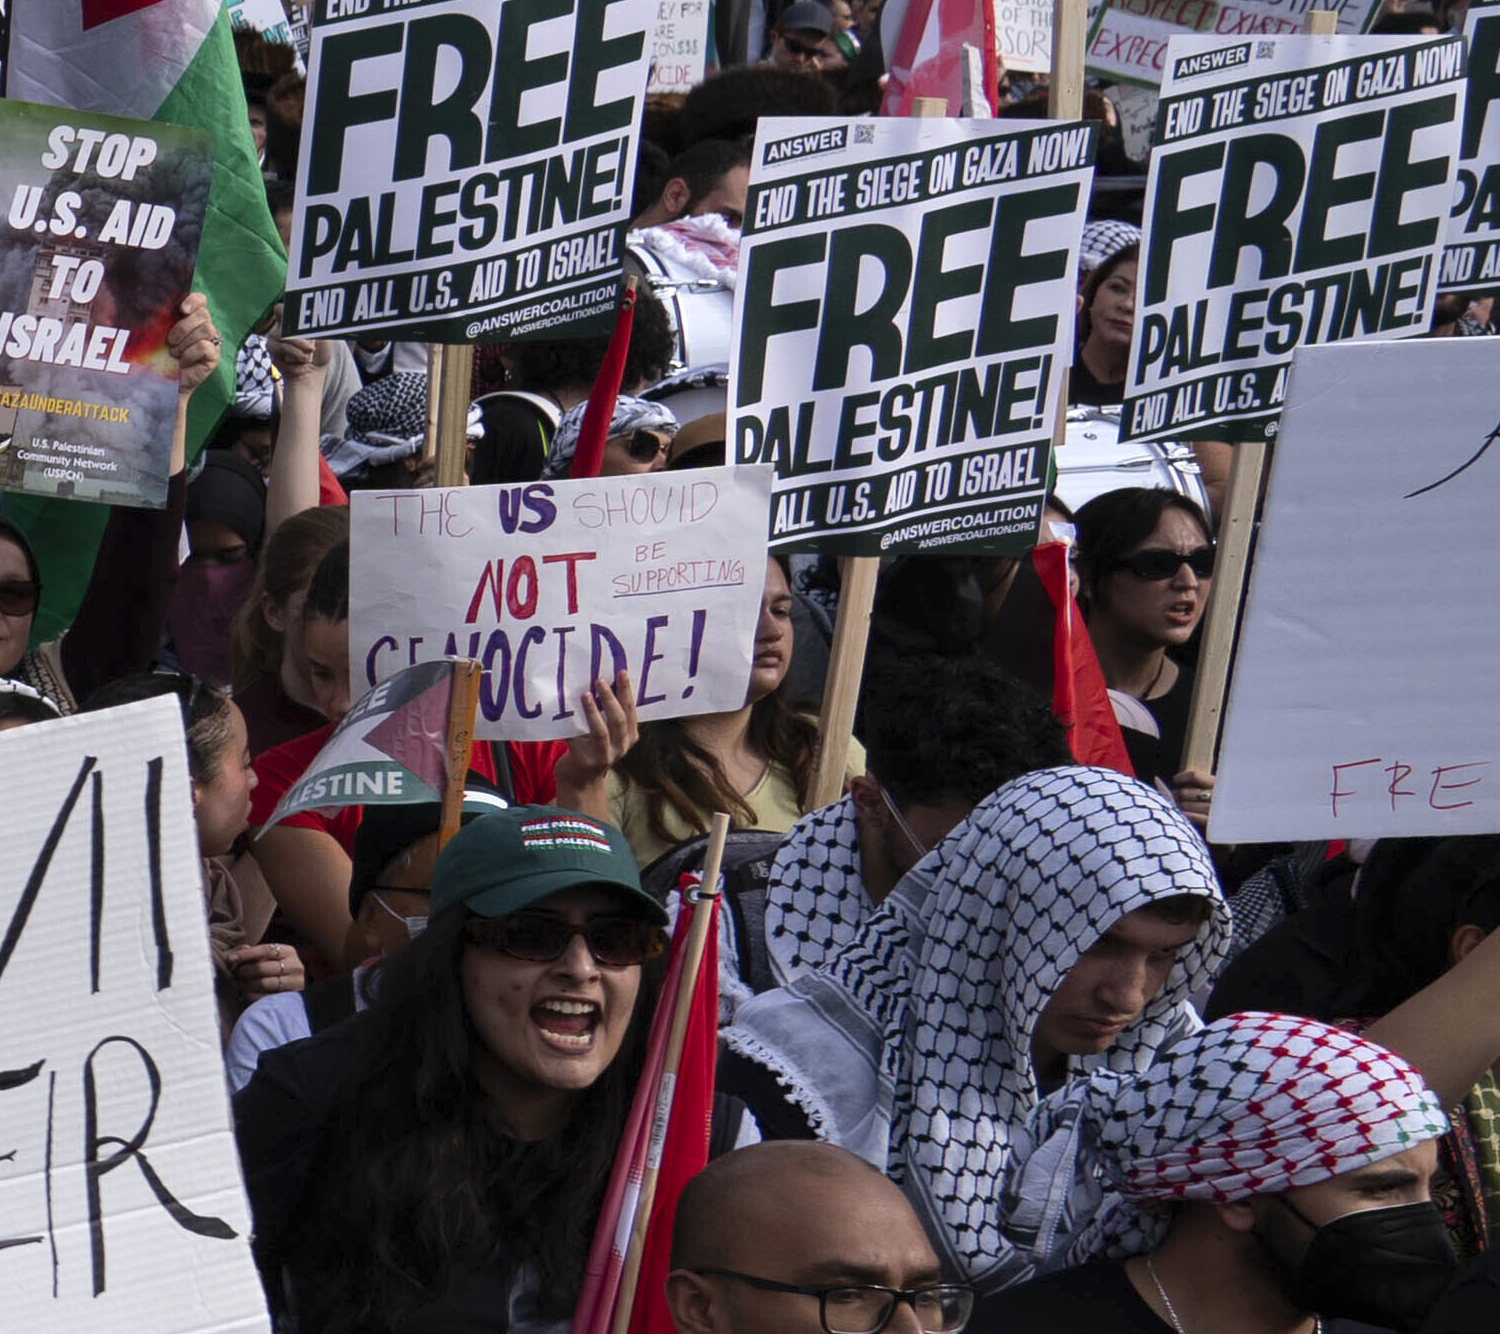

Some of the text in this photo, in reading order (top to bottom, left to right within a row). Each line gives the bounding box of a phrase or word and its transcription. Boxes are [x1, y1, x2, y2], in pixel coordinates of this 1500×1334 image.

[41, 125, 157, 181] STOP
[7, 184, 176, 250] U.S. AID
[299, 137, 628, 279] PALESTINE!
[1146, 94, 1457, 302] FREE
[49, 256, 104, 303] TO
[1136, 255, 1432, 385] PALESTINE!
[17, 451, 118, 471] Community Network
[32, 438, 105, 457] U.S. Palestinian
[43, 468, 84, 483] (USPCN)
[377, 490, 473, 538] THE
[499, 484, 557, 534] US
[612, 559, 744, 595] SUPPORTING
[635, 542, 667, 562] BE
[466, 552, 596, 624] NOT
